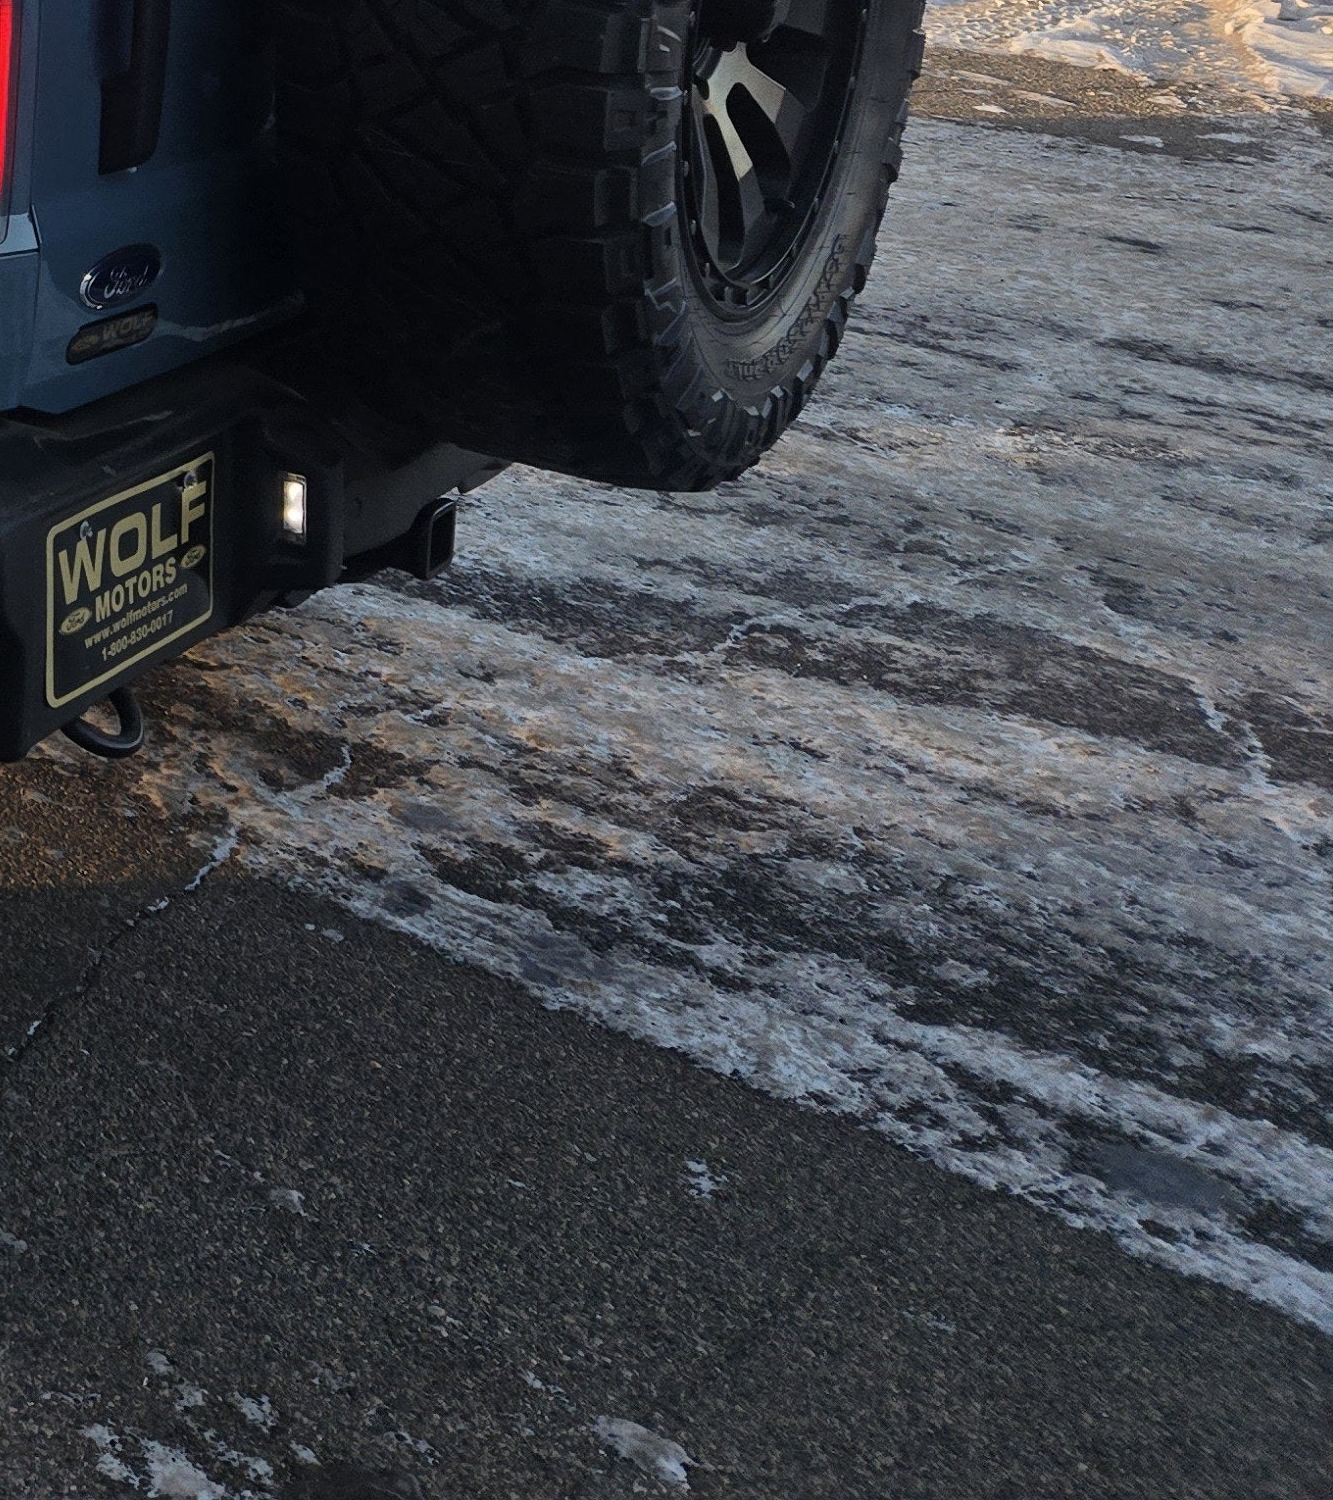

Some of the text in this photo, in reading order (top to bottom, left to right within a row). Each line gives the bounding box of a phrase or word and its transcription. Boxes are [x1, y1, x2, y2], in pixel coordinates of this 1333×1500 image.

[103, 264, 151, 299] Ford
[58, 481, 207, 605] WOLF
[85, 583, 188, 648] www.wolfmotors.com
[95, 556, 177, 623] MOTORS
